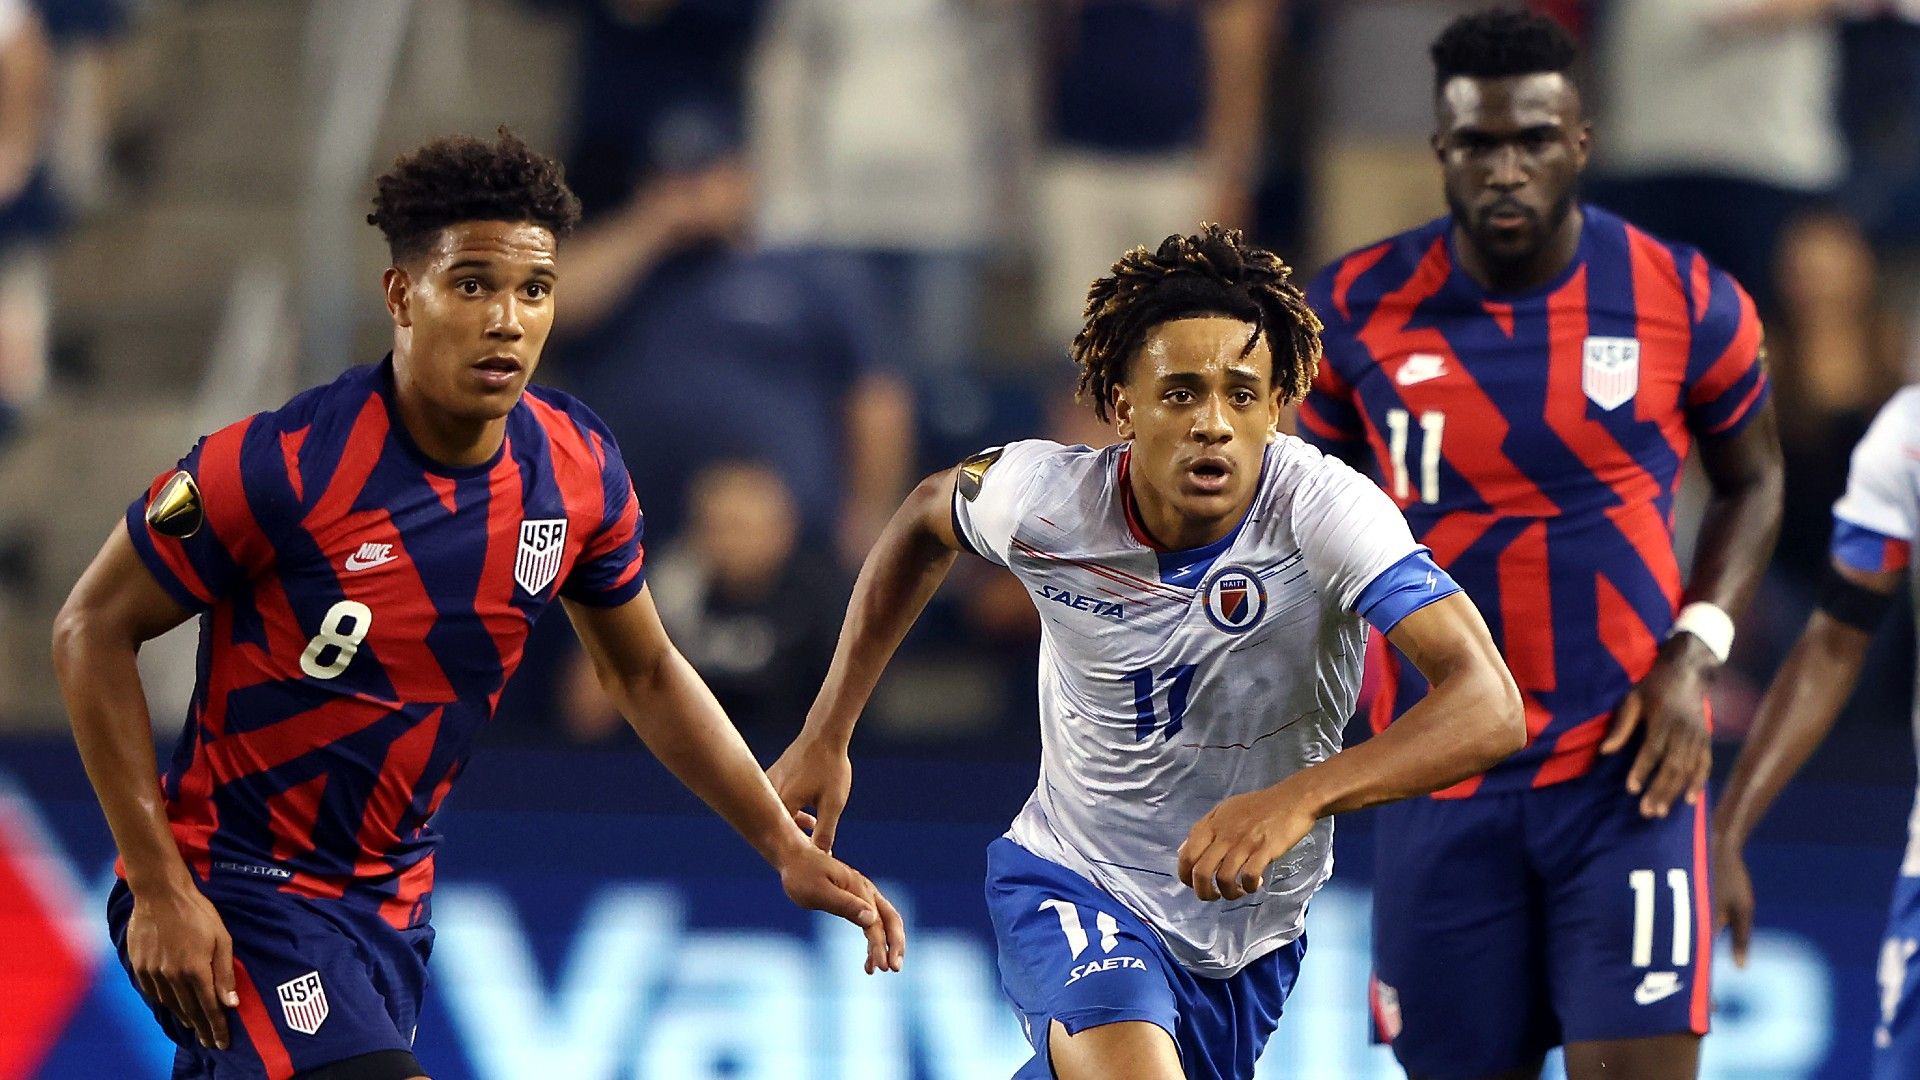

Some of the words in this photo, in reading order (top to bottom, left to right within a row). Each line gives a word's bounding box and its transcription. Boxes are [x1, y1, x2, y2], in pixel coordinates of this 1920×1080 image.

[1590, 345, 1633, 367] USA
[1386, 408, 1446, 505] 11
[355, 543, 394, 561] NIKE
[524, 524, 563, 551] USA
[1222, 580, 1244, 588] HAITI
[1035, 584, 1124, 618] SAETA
[300, 600, 372, 679] 8
[1629, 868, 1691, 967] 11
[1063, 956, 1147, 987] SAETA
[280, 975, 319, 1002] USA
